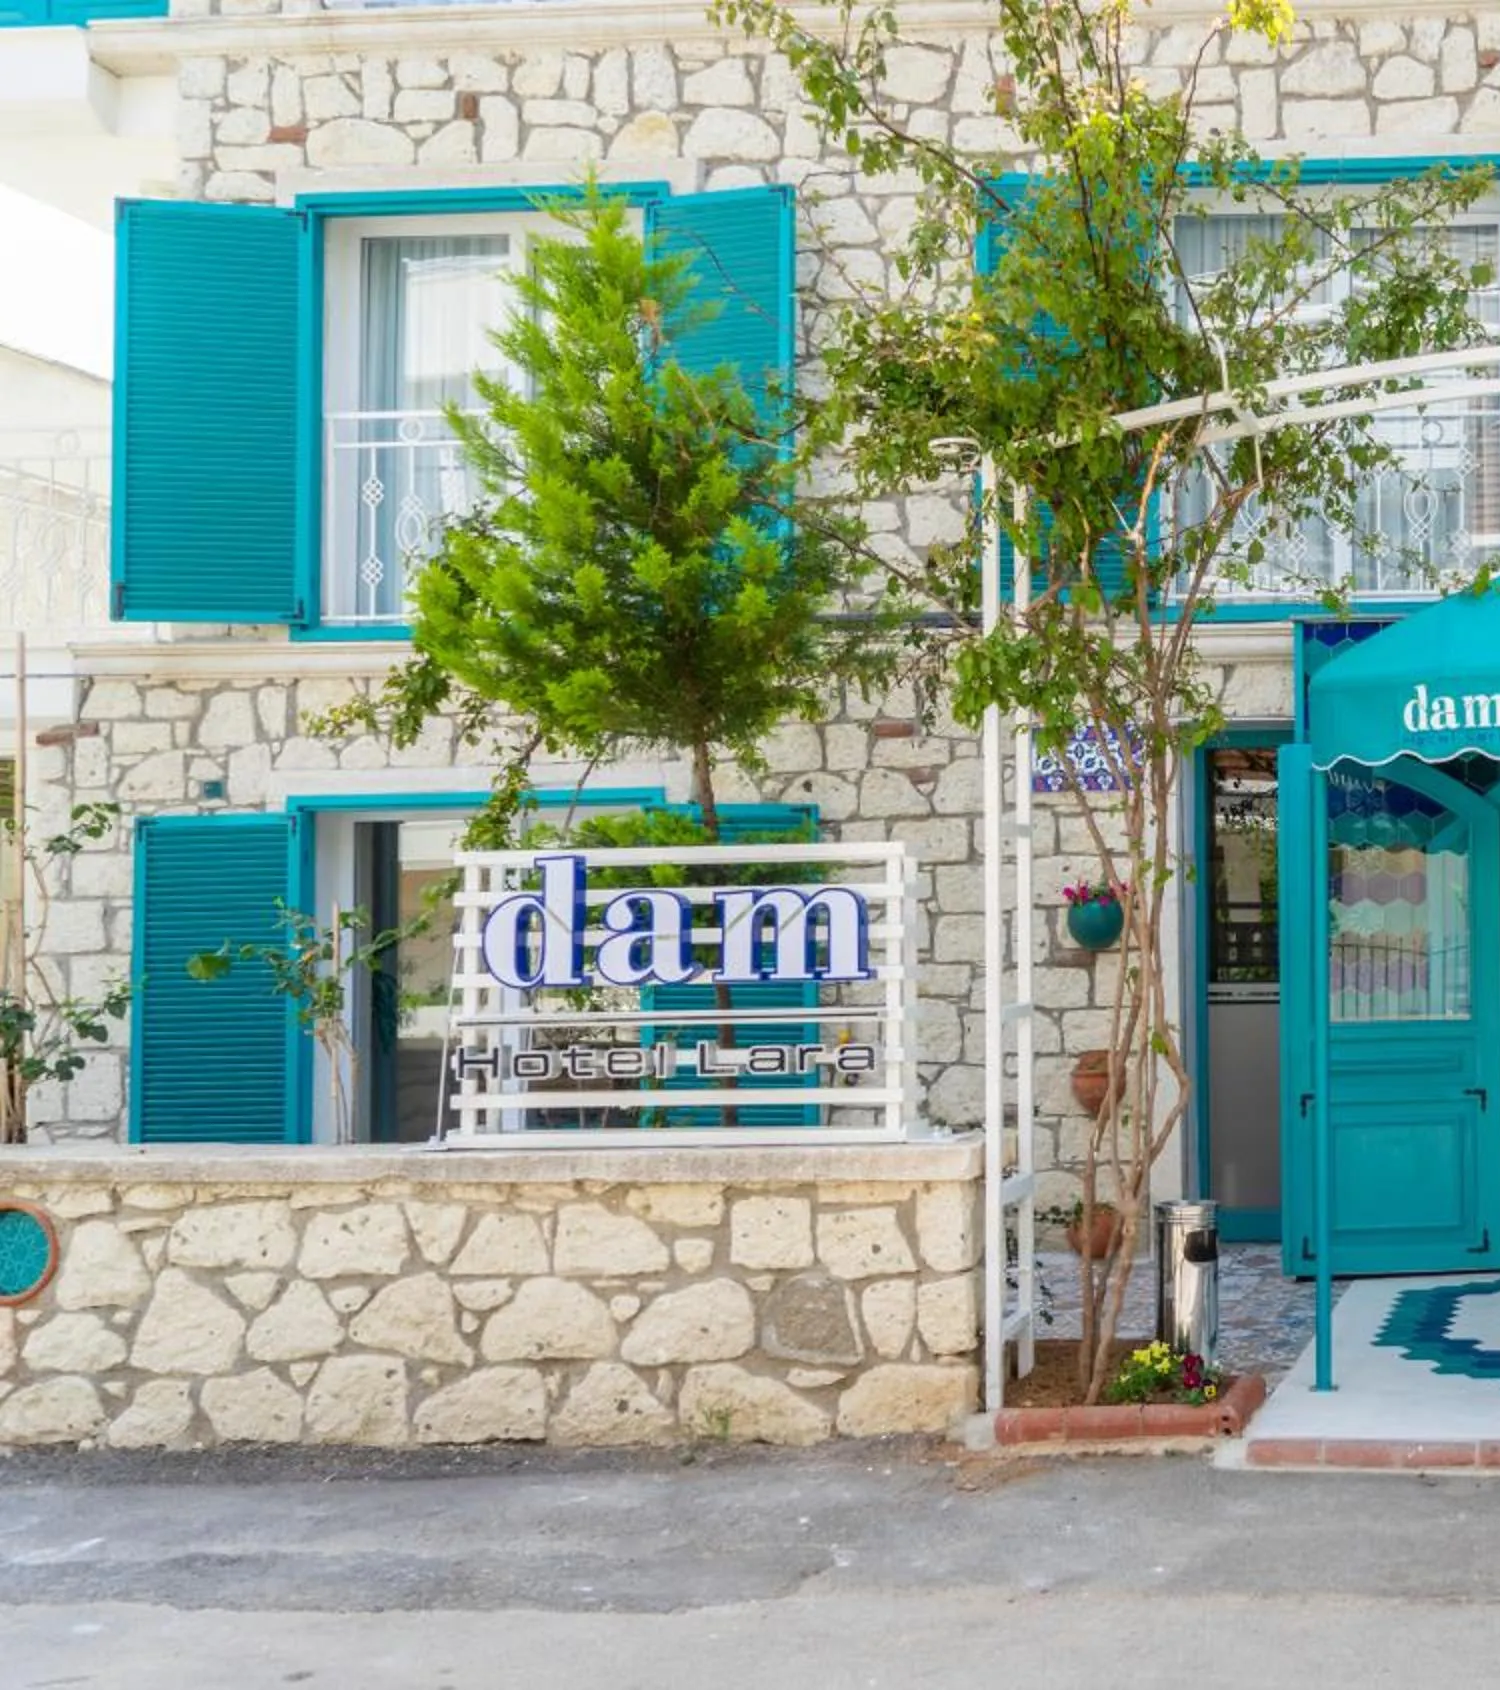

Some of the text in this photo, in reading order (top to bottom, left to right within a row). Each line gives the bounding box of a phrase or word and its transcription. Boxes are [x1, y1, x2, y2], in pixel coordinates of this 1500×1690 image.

[482, 855, 877, 991] dam
[454, 1038, 879, 1081] Hotel Lara
